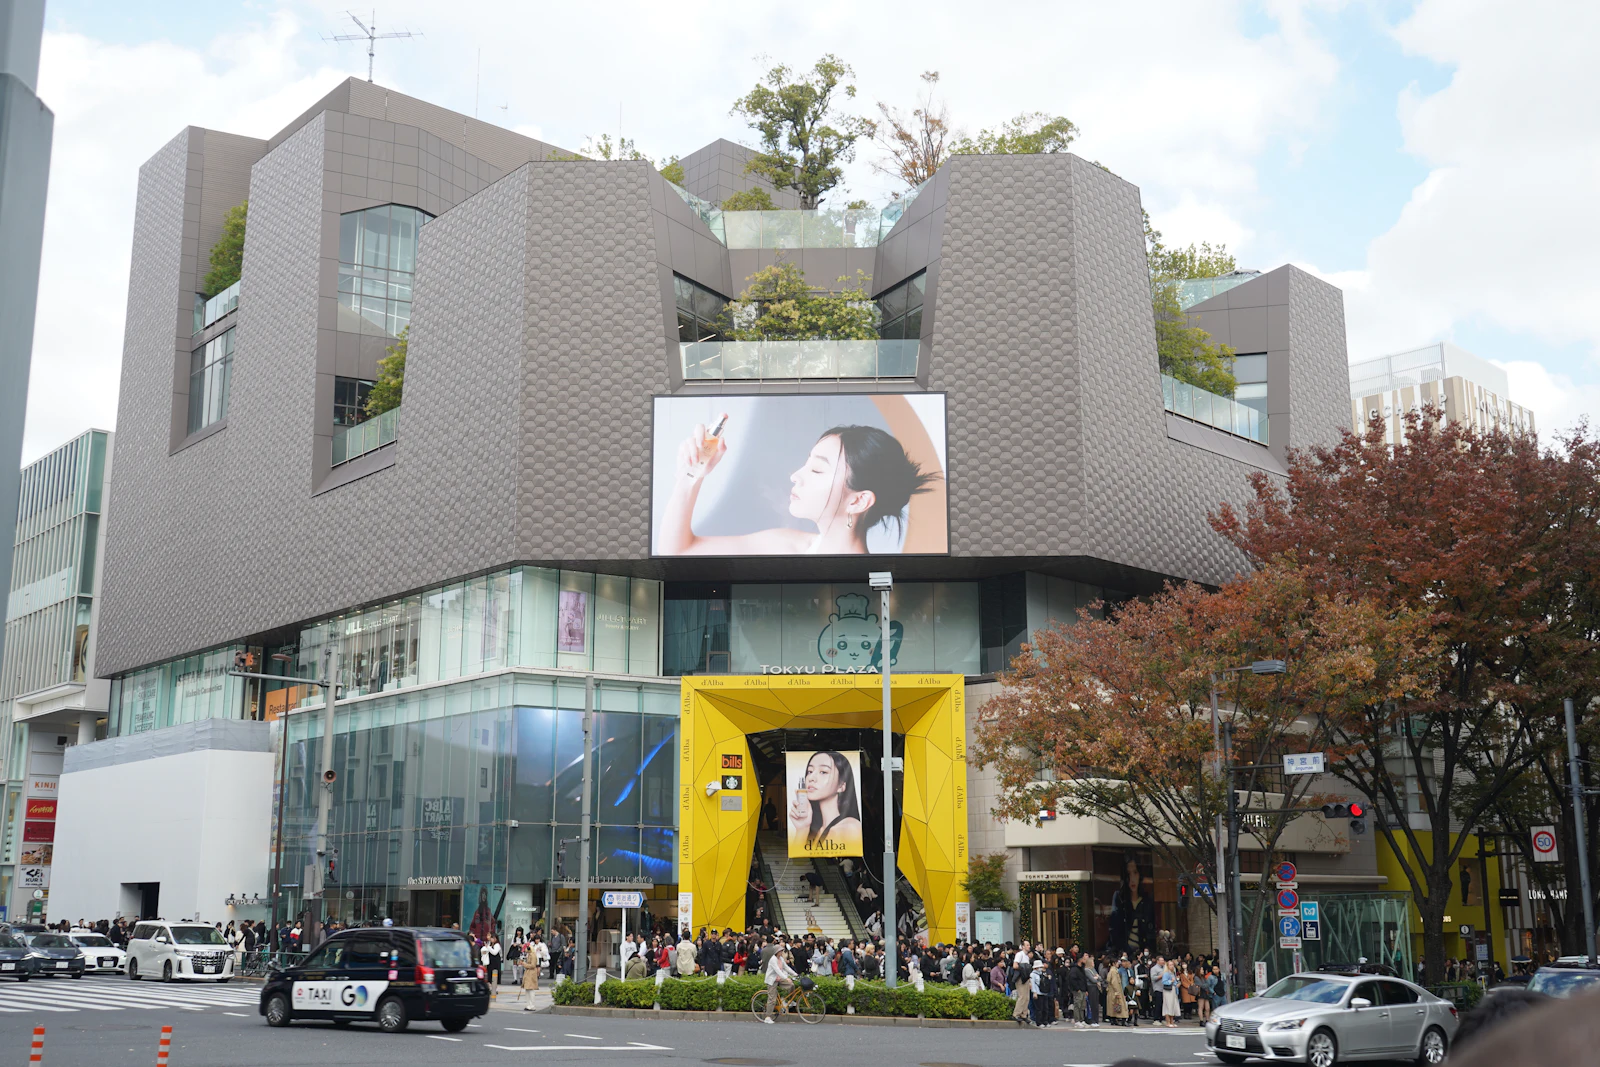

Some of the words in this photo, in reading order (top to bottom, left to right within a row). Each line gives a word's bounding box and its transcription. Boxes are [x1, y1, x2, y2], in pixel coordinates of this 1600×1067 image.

[597, 613, 647, 625] JILLSTART
[346, 620, 362, 636] JILL
[760, 664, 816, 675] TOKYU
[821, 664, 879, 675] PLAZA
[830, 678, 853, 686] d'Alba
[918, 678, 941, 686] d'Alba
[722, 755, 742, 768] bills
[1287, 756, 1321, 766] 神宮前
[682, 787, 690, 811] d'Alba
[804, 839, 846, 851] d'Alba
[1537, 837, 1551, 847] 50
[1528, 889, 1568, 900] LONGHAMP
[1283, 921, 1292, 935] P
[308, 987, 332, 1001] TAXI
[341, 984, 368, 1007] GO
